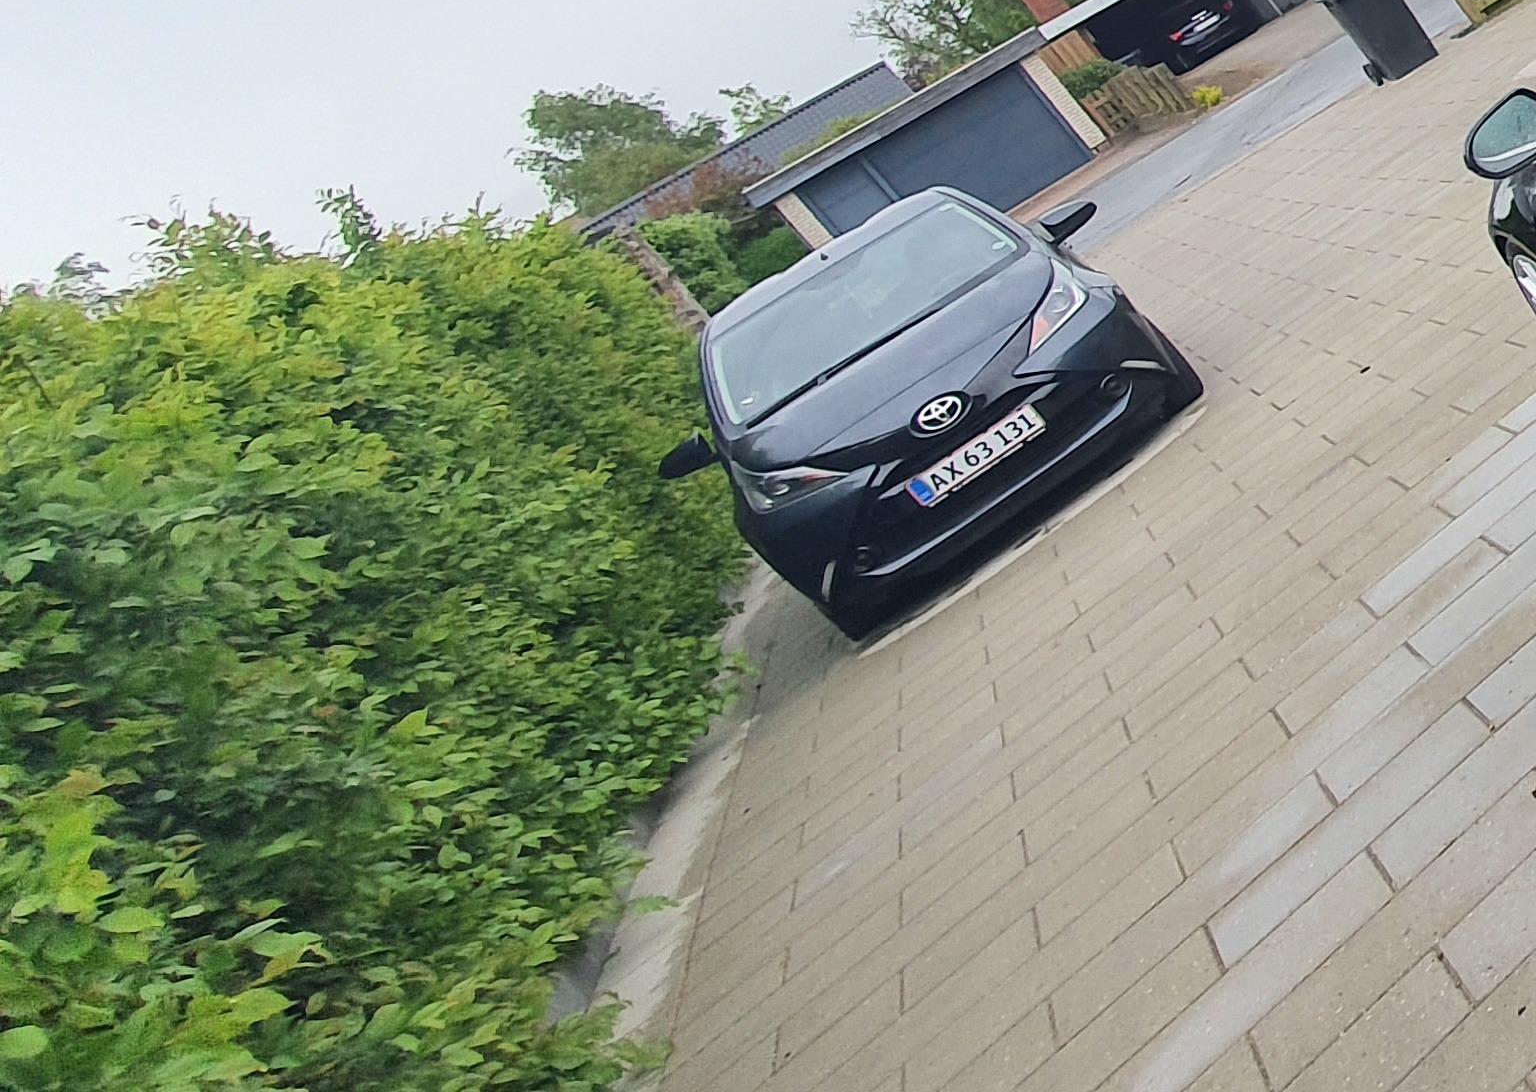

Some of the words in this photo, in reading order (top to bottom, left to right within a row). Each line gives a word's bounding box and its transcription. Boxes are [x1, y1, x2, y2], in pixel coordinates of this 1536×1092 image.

[930, 461, 964, 491] AX
[964, 441, 994, 466] 63
[994, 414, 1035, 446] 131
